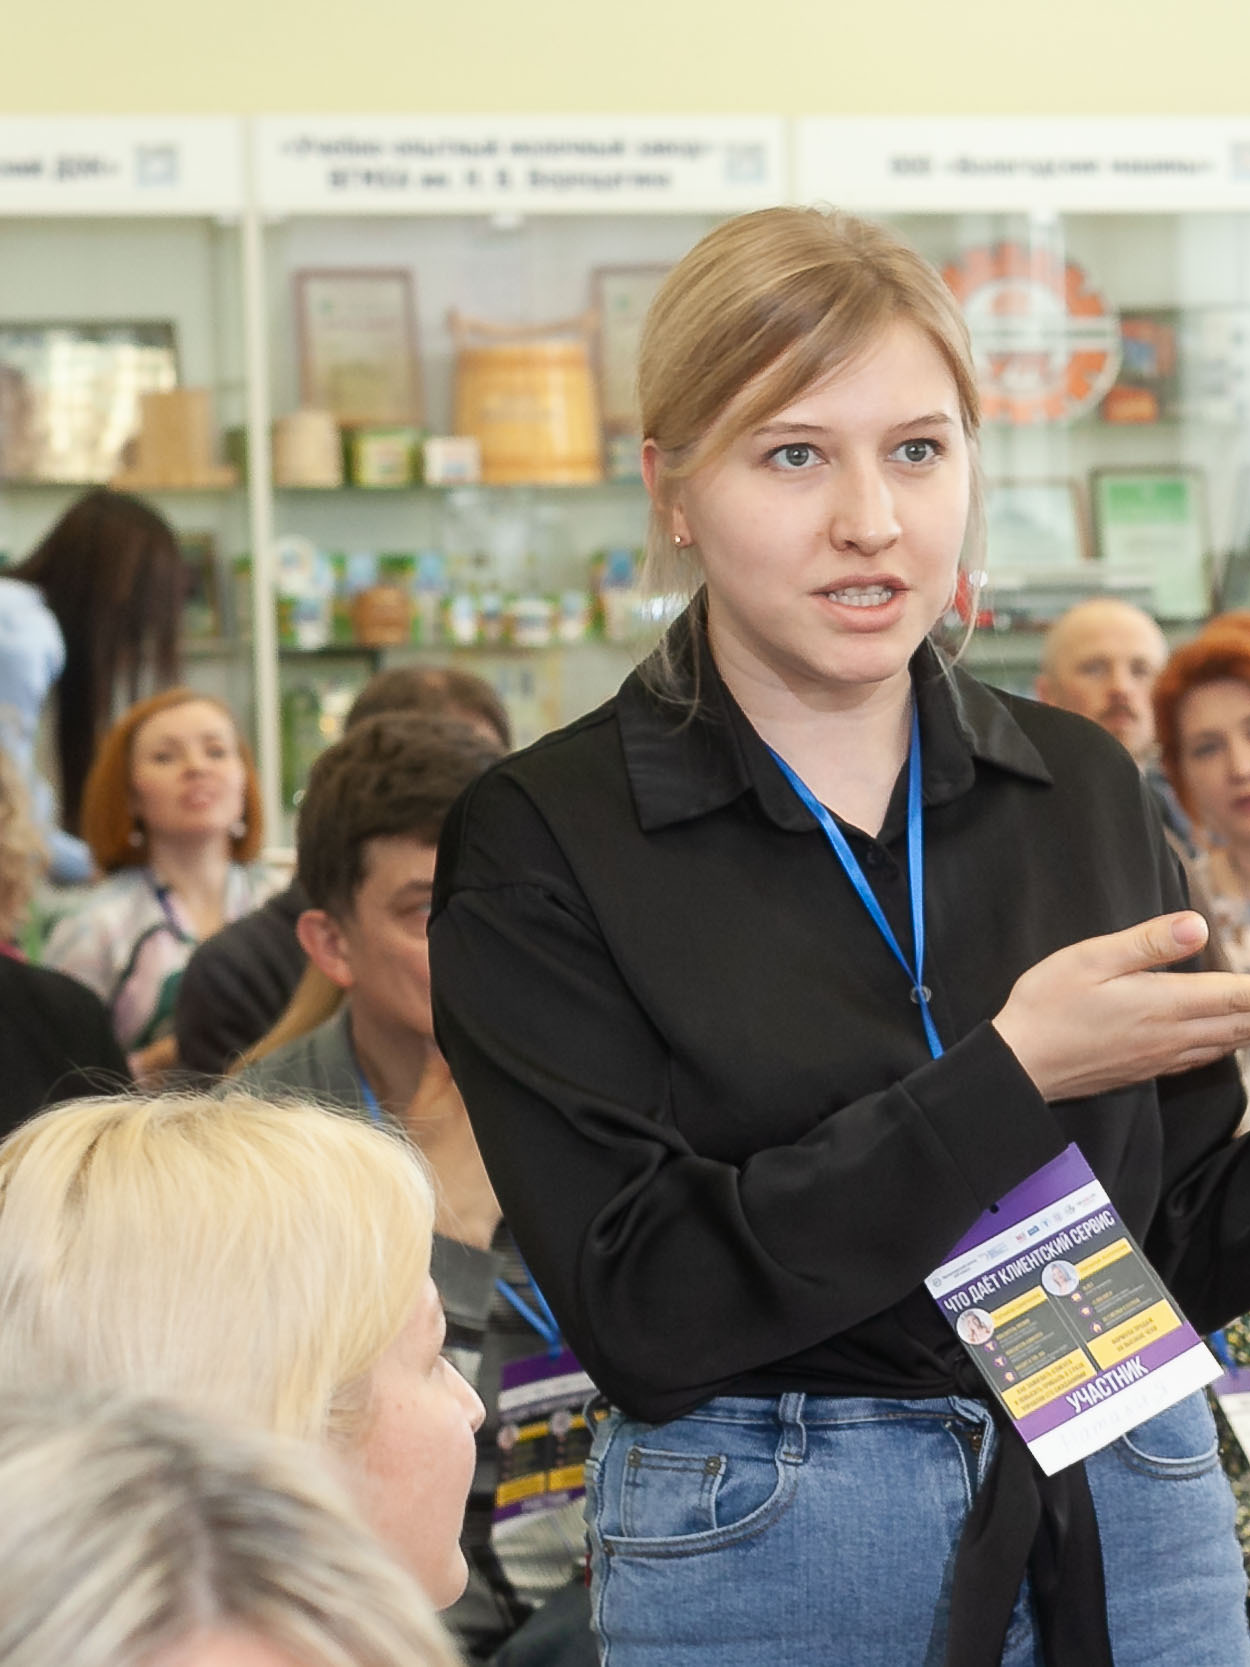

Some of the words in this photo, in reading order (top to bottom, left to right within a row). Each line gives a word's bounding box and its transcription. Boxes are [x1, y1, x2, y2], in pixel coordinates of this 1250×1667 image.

[943, 1290, 971, 1315] ЧТО
[966, 1272, 1003, 1304] ДАЁТ
[996, 1230, 1075, 1286] КЛИЕНТСКИЙ
[1068, 1209, 1116, 1245] СЕРВИС
[1065, 1354, 1150, 1415] УЧАСТНИК
